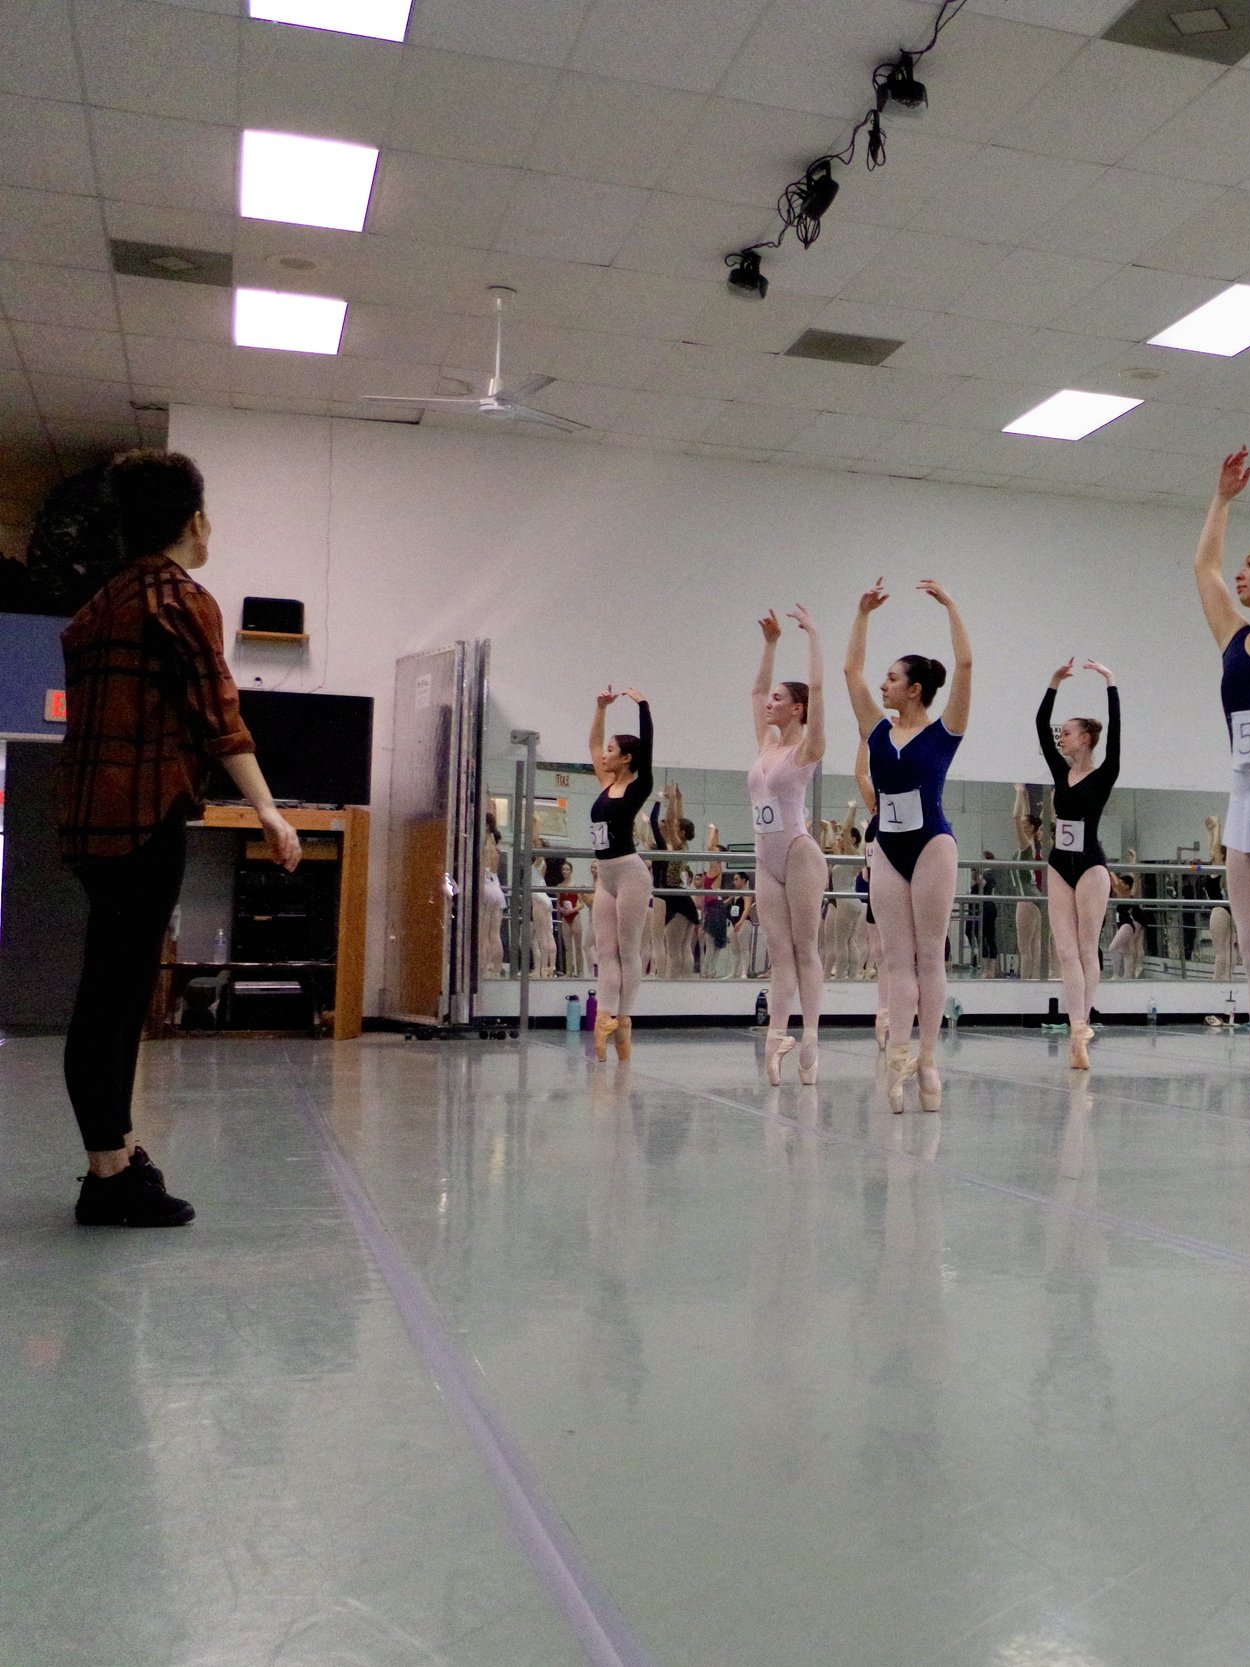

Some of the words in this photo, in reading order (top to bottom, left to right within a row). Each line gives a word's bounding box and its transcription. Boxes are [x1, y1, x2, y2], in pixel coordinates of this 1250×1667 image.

[755, 805, 774, 825] 20
[887, 801, 903, 824] 1
[1062, 824, 1075, 846] 5
